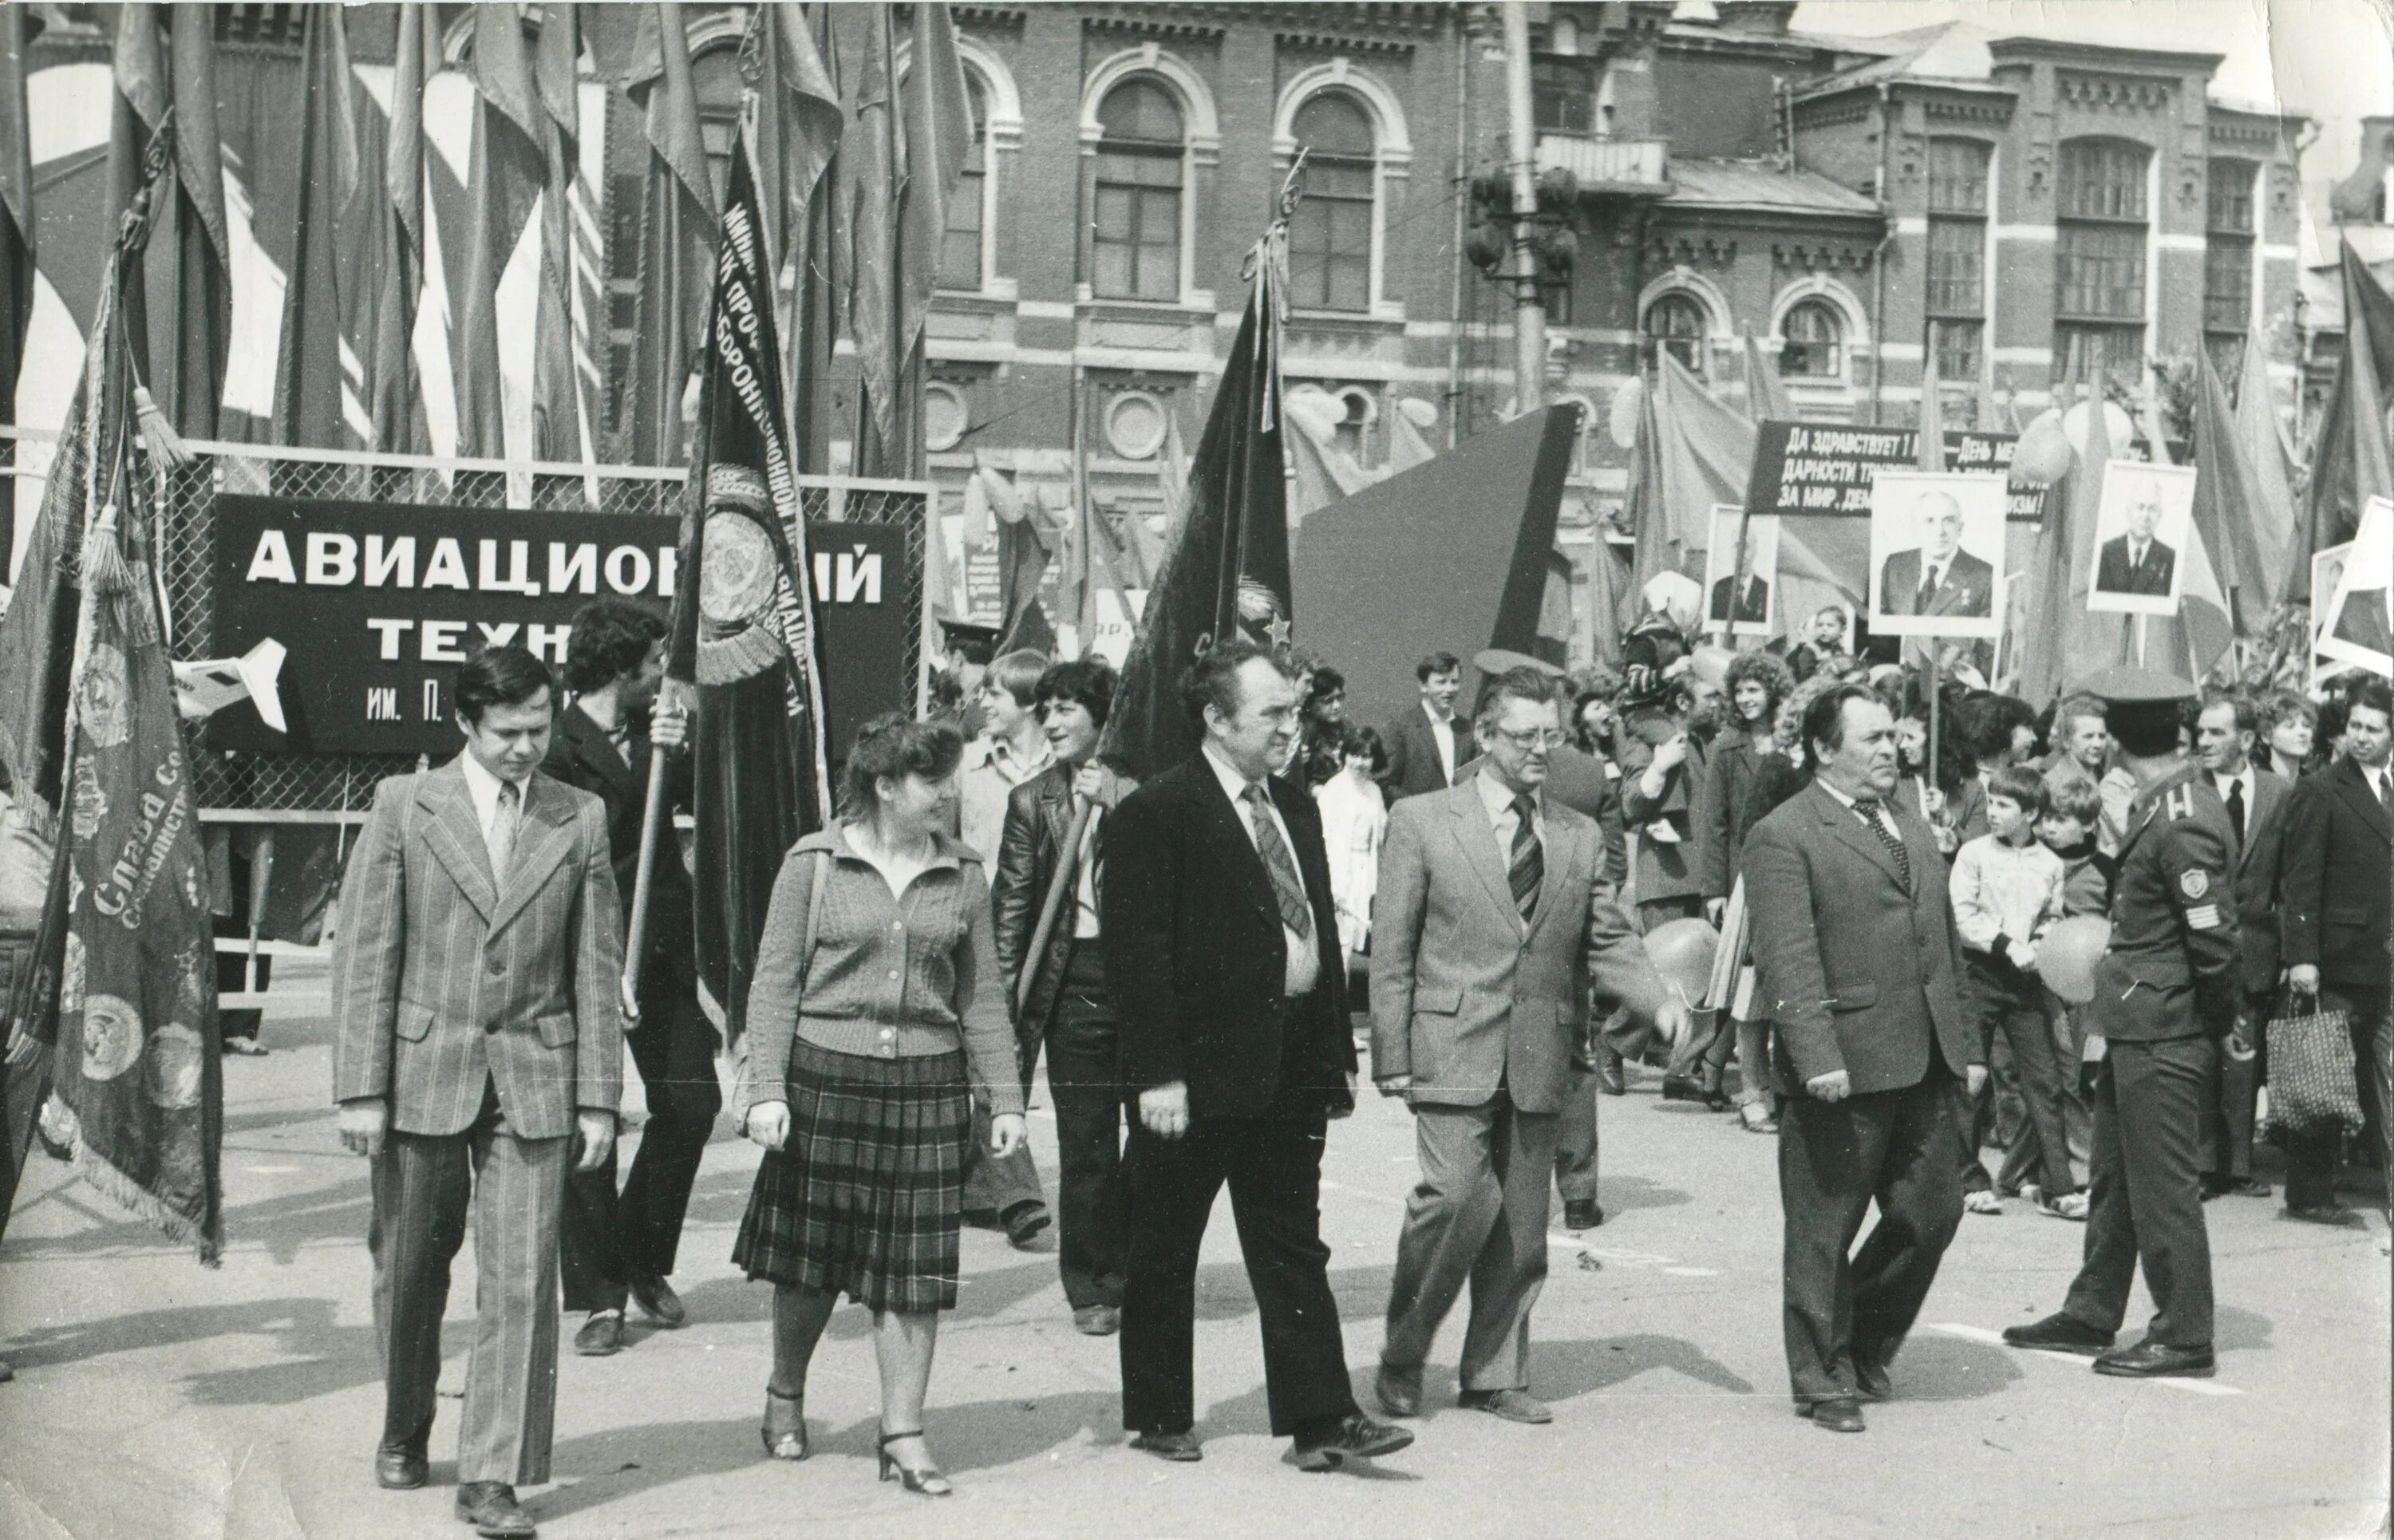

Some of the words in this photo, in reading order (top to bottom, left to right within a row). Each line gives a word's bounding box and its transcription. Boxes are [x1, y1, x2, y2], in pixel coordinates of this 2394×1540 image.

[1785, 427, 1809, 455] ДА
[1811, 431, 1901, 456] ЗДРАВСТВУЕТ
[1780, 458, 1857, 484] ДАРНОСТИ
[1777, 485, 1799, 507] ЗА
[1841, 488, 1873, 511] ДЕМ
[367, 618, 573, 664] ТЕХН
[423, 679, 442, 721] П.
